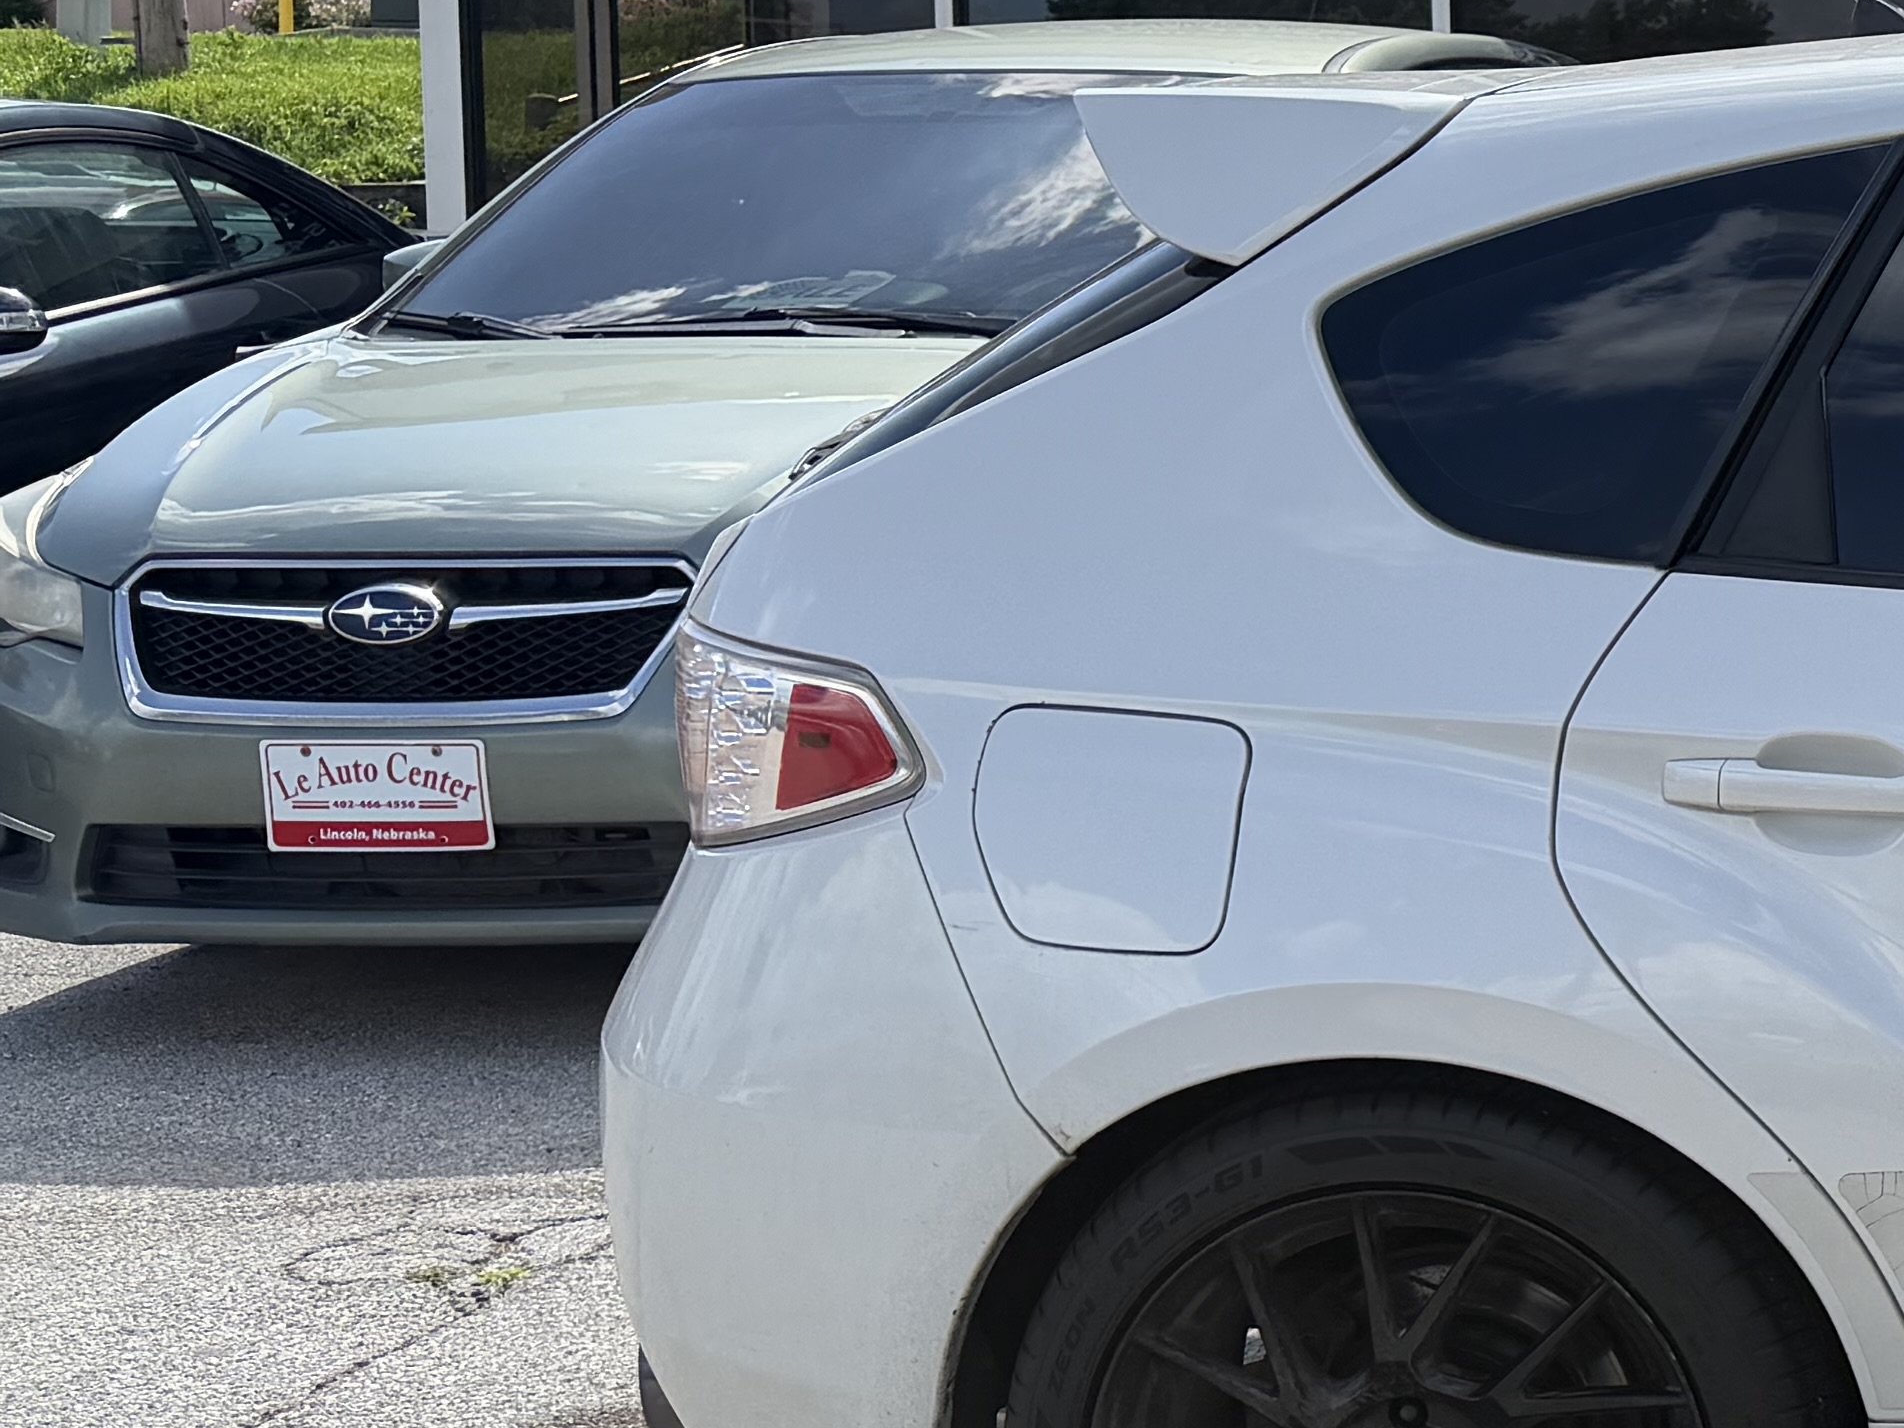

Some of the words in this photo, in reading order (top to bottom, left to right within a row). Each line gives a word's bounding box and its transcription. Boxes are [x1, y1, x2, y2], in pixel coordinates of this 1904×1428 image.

[273, 770, 312, 800] Le
[317, 756, 378, 789] Auto
[386, 752, 477, 802] Center
[320, 828, 370, 841] Lincoln,
[373, 829, 435, 841] Nebraska
